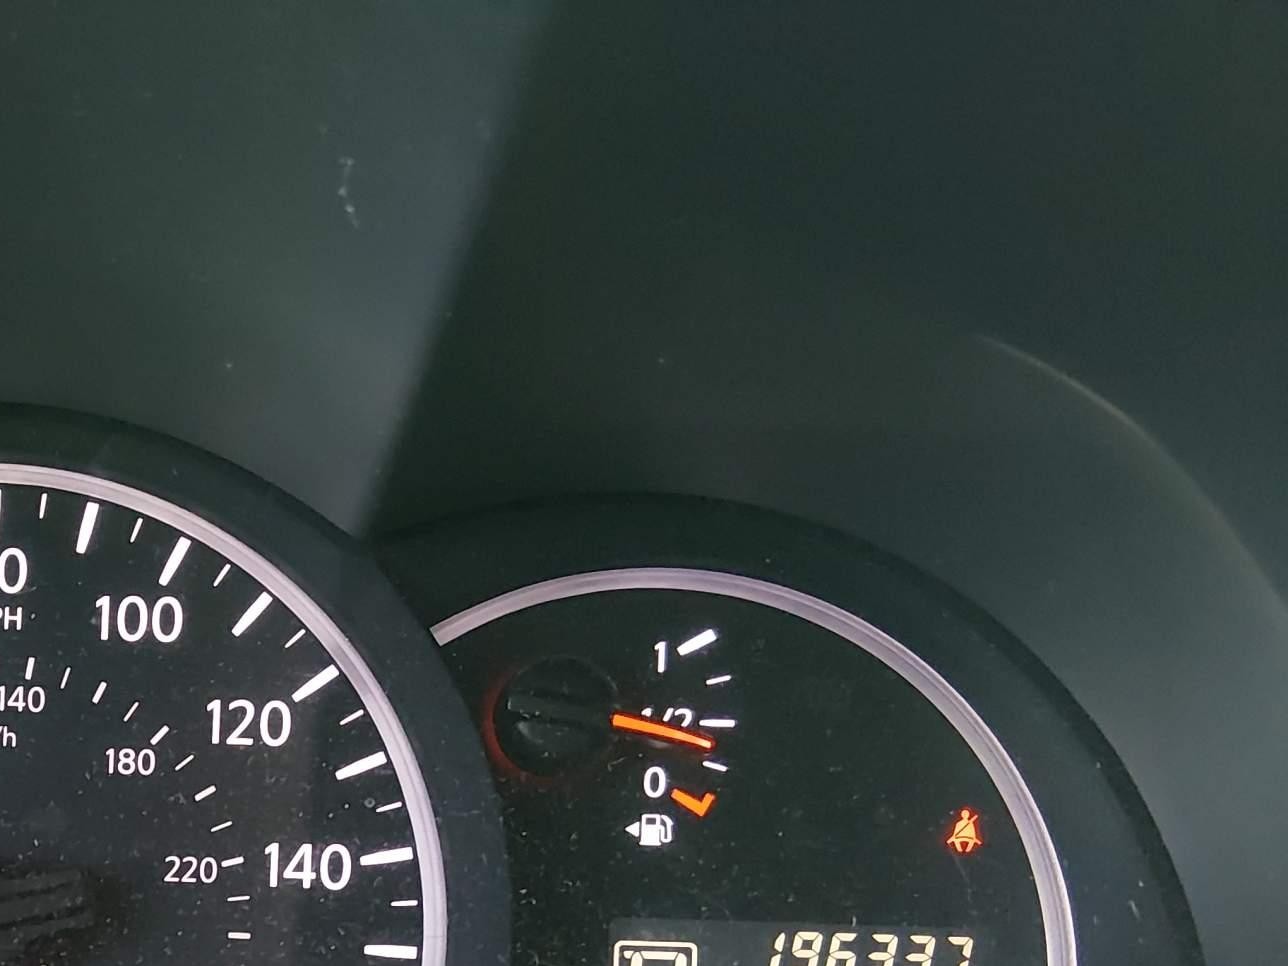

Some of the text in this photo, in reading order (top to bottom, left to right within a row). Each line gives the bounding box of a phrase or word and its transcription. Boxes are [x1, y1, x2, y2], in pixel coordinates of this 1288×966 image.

[95, 595, 184, 644] 100
[654, 641, 667, 673] 1
[206, 698, 292, 748] 120
[105, 747, 156, 776] 180
[643, 766, 666, 798] 0
[163, 856, 218, 884] 220
[264, 842, 352, 891] 140
